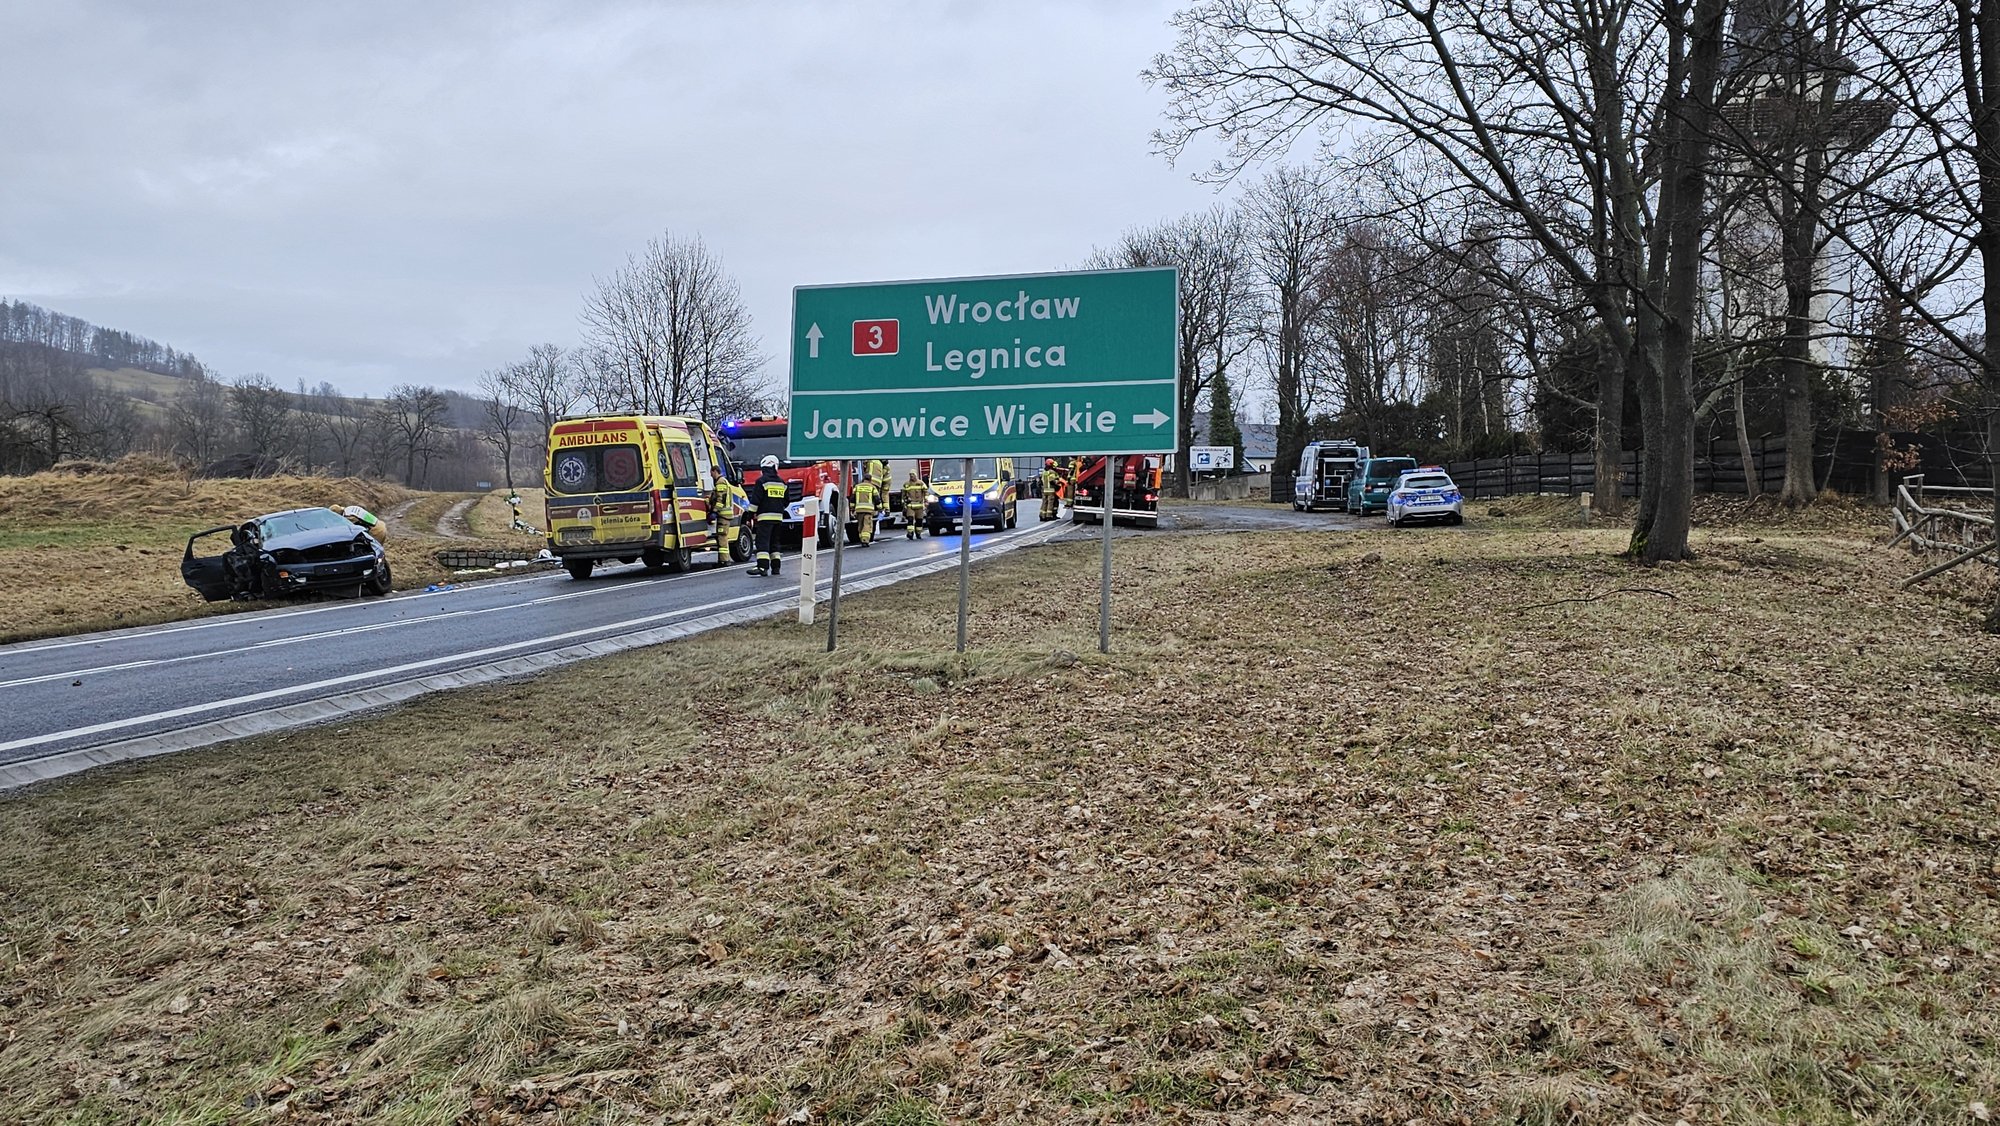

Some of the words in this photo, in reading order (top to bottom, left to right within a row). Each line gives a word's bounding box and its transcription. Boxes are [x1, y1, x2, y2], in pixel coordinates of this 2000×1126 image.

[925, 292, 1081, 325] Wrocław
[868, 325, 884, 350] 3
[926, 338, 1066, 379] Legnica
[804, 408, 969, 439] Janowice
[985, 402, 1117, 435] Wielkie
[559, 432, 628, 447] AMBULANS
[601, 517, 623, 525] Jelenia
